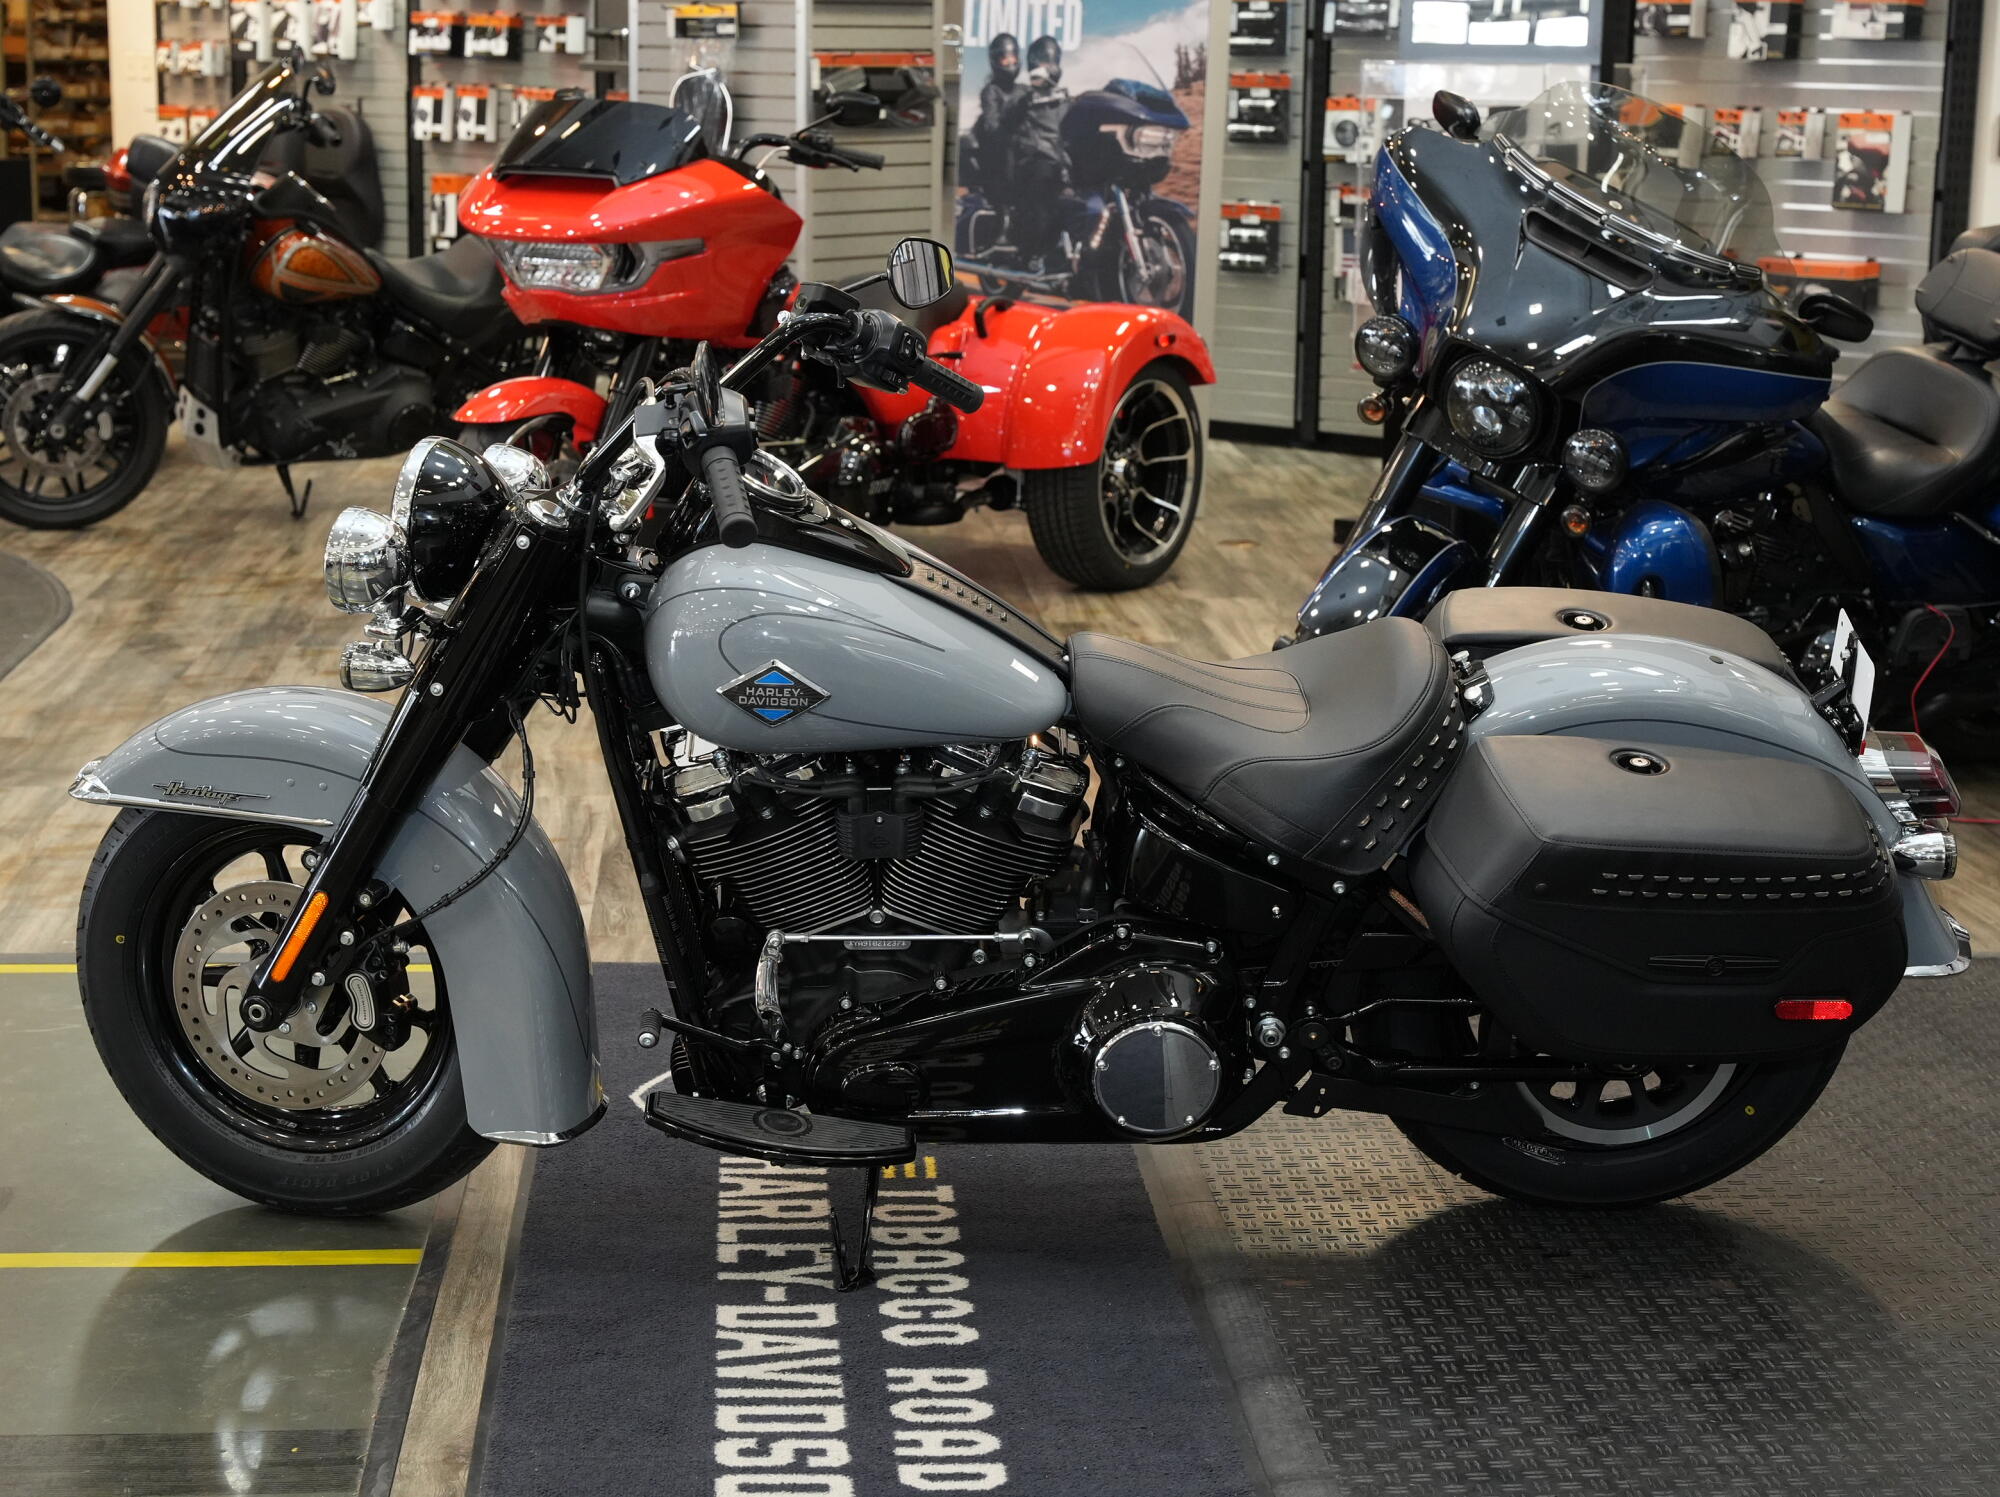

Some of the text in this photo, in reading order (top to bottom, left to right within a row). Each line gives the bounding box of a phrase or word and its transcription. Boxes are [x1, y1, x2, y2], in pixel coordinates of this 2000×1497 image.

[963, 0, 1082, 51] LIMITED
[738, 695, 809, 707] DAVIDSON
[746, 687, 804, 697] HARLEY-
[163, 780, 241, 805] Heritage
[871, 1184, 1008, 1491] TOBACCO ROAD
